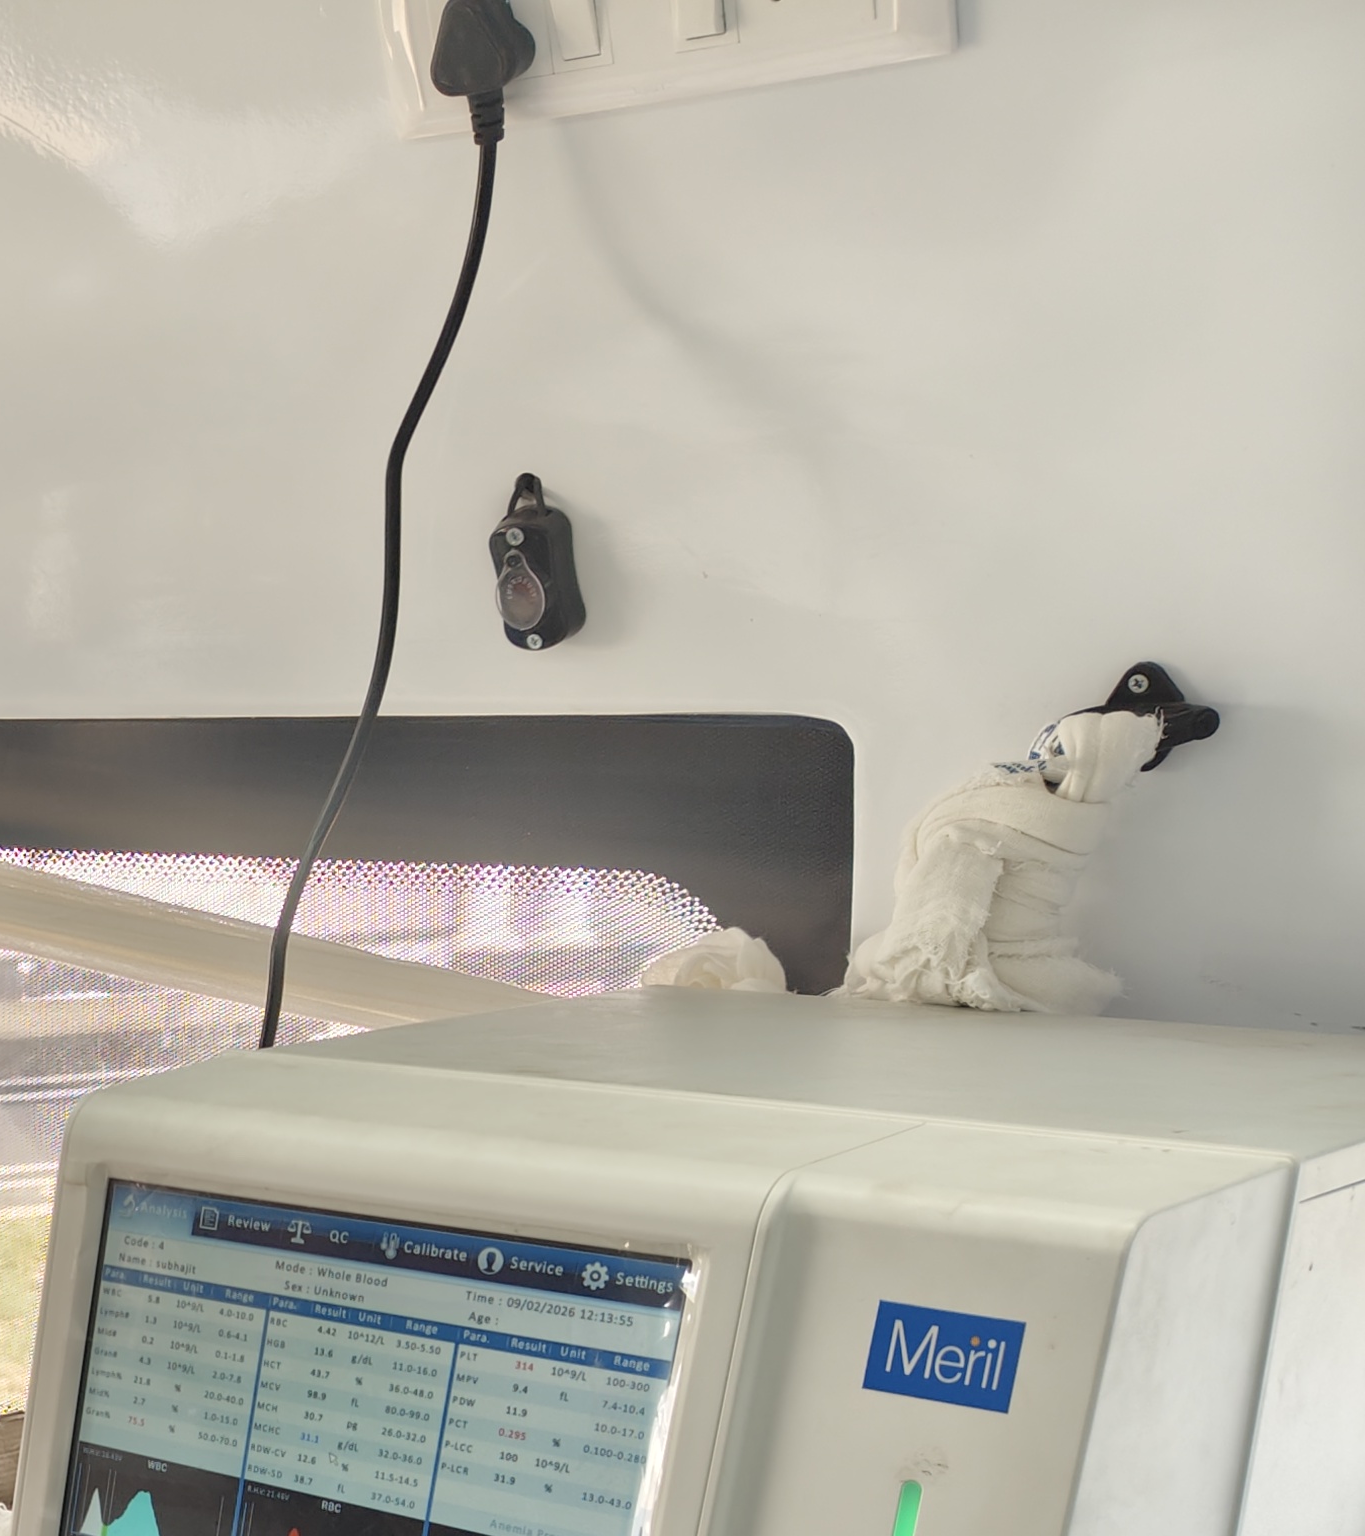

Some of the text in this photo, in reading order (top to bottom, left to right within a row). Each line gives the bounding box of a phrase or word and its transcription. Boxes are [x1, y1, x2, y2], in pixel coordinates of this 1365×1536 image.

[139, 1202, 187, 1219] Analysis
[227, 1214, 271, 1232] Review
[124, 1235, 149, 1249] Code
[329, 1230, 349, 1244] QC
[119, 1252, 197, 1276] Name subhajit
[403, 1241, 468, 1263] Calibrate
[510, 1256, 564, 1276] Service
[275, 1259, 389, 1288] Mode Whole Blood
[615, 1272, 674, 1294] Settings
[142, 1273, 255, 1304] Result Unit Range
[284, 1280, 365, 1303] Sex Unknown
[219, 1308, 255, 1322] 4.0-10.0
[314, 1304, 347, 1319] Result
[358, 1311, 382, 1325] Unit
[405, 1319, 439, 1336] Range
[466, 1290, 634, 1327] Time 09/02/2026 12:13:55
[468, 1311, 491, 1325] Age
[218, 1329, 248, 1342] 0.6-4.1
[270, 1316, 288, 1328] RBC
[317, 1325, 337, 1337] 4.42
[395, 1339, 442, 1356] 3.50-5.50
[266, 1338, 438, 1378] HGB 13.6 11.0-16.0
[463, 1329, 651, 1372] Para. Result Unit Range
[884, 1318, 1007, 1391] Meril
[263, 1360, 434, 1400] HCT 43.7 36.0-48.0
[459, 1350, 478, 1362] PLT
[514, 1360, 534, 1373] 314
[605, 1376, 651, 1393] 100-300
[204, 1390, 244, 1406] 20.0-40.0
[260, 1380, 431, 1422] MCV 98.9 80.0-99.0
[456, 1373, 646, 1416] MPV 9.4 7.4-10.4
[203, 1411, 239, 1426] 1.0-15.0
[257, 1401, 427, 1444] MCH 30.7 26.0-32.0
[452, 1395, 645, 1440] PDW 11.9 10.0-17.0
[198, 1431, 238, 1447] 50.0-70.0
[253, 1422, 423, 1466] MCHC 31.1 32.0-36.0
[444, 1439, 473, 1454] P-LCC
[499, 1451, 519, 1463] 100
[448, 1417, 647, 1465] PCT 0.295 0.100-0.280
[147, 1459, 168, 1472] WBC
[250, 1443, 419, 1488] RDW-CV 12.6 11.5-14.5
[247, 1463, 416, 1510] RDW-SD 38.7 37.0-54.0
[440, 1461, 633, 1511] P-LCR 31.9 13.0-43.0
[321, 1500, 343, 1514] RBC
